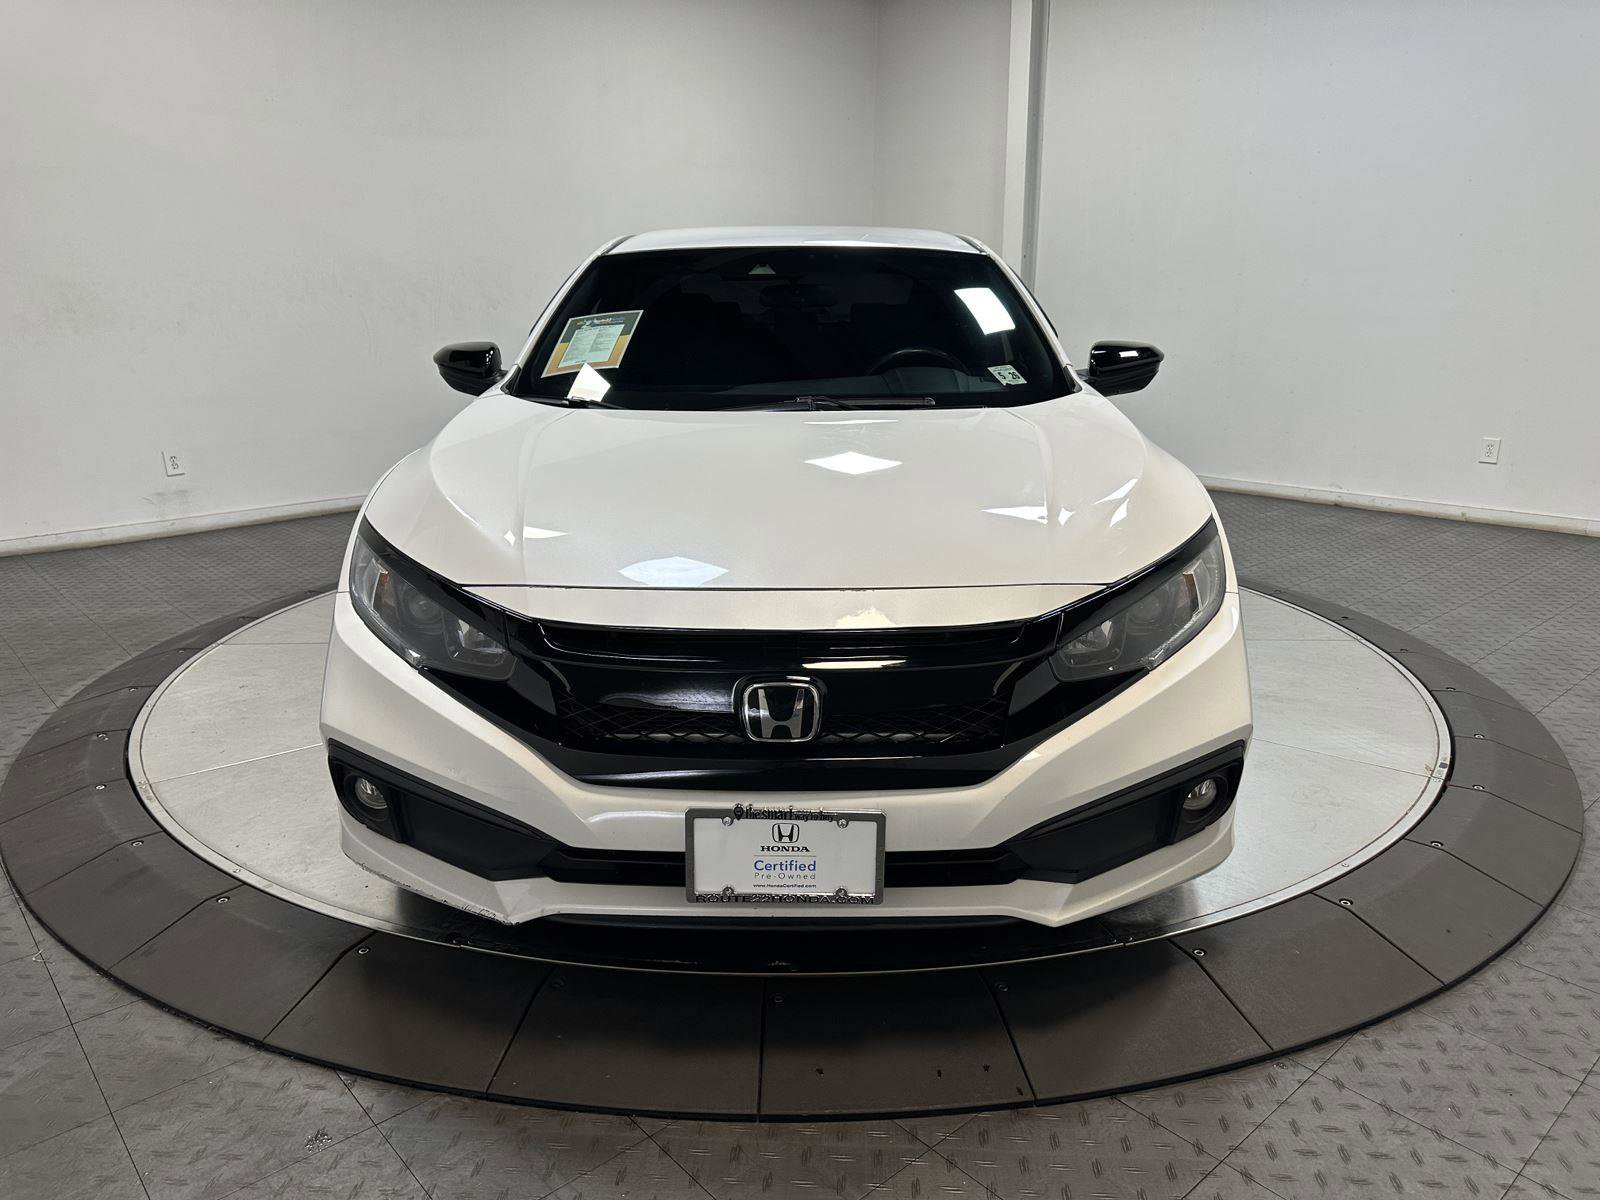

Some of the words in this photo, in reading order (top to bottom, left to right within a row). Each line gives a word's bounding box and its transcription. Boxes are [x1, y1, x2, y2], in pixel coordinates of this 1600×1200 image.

[761, 807, 793, 820] smart
[794, 812, 809, 822] way
[754, 860, 816, 871] Certified
[695, 894, 874, 905] ROUTE22HONDA.COM
